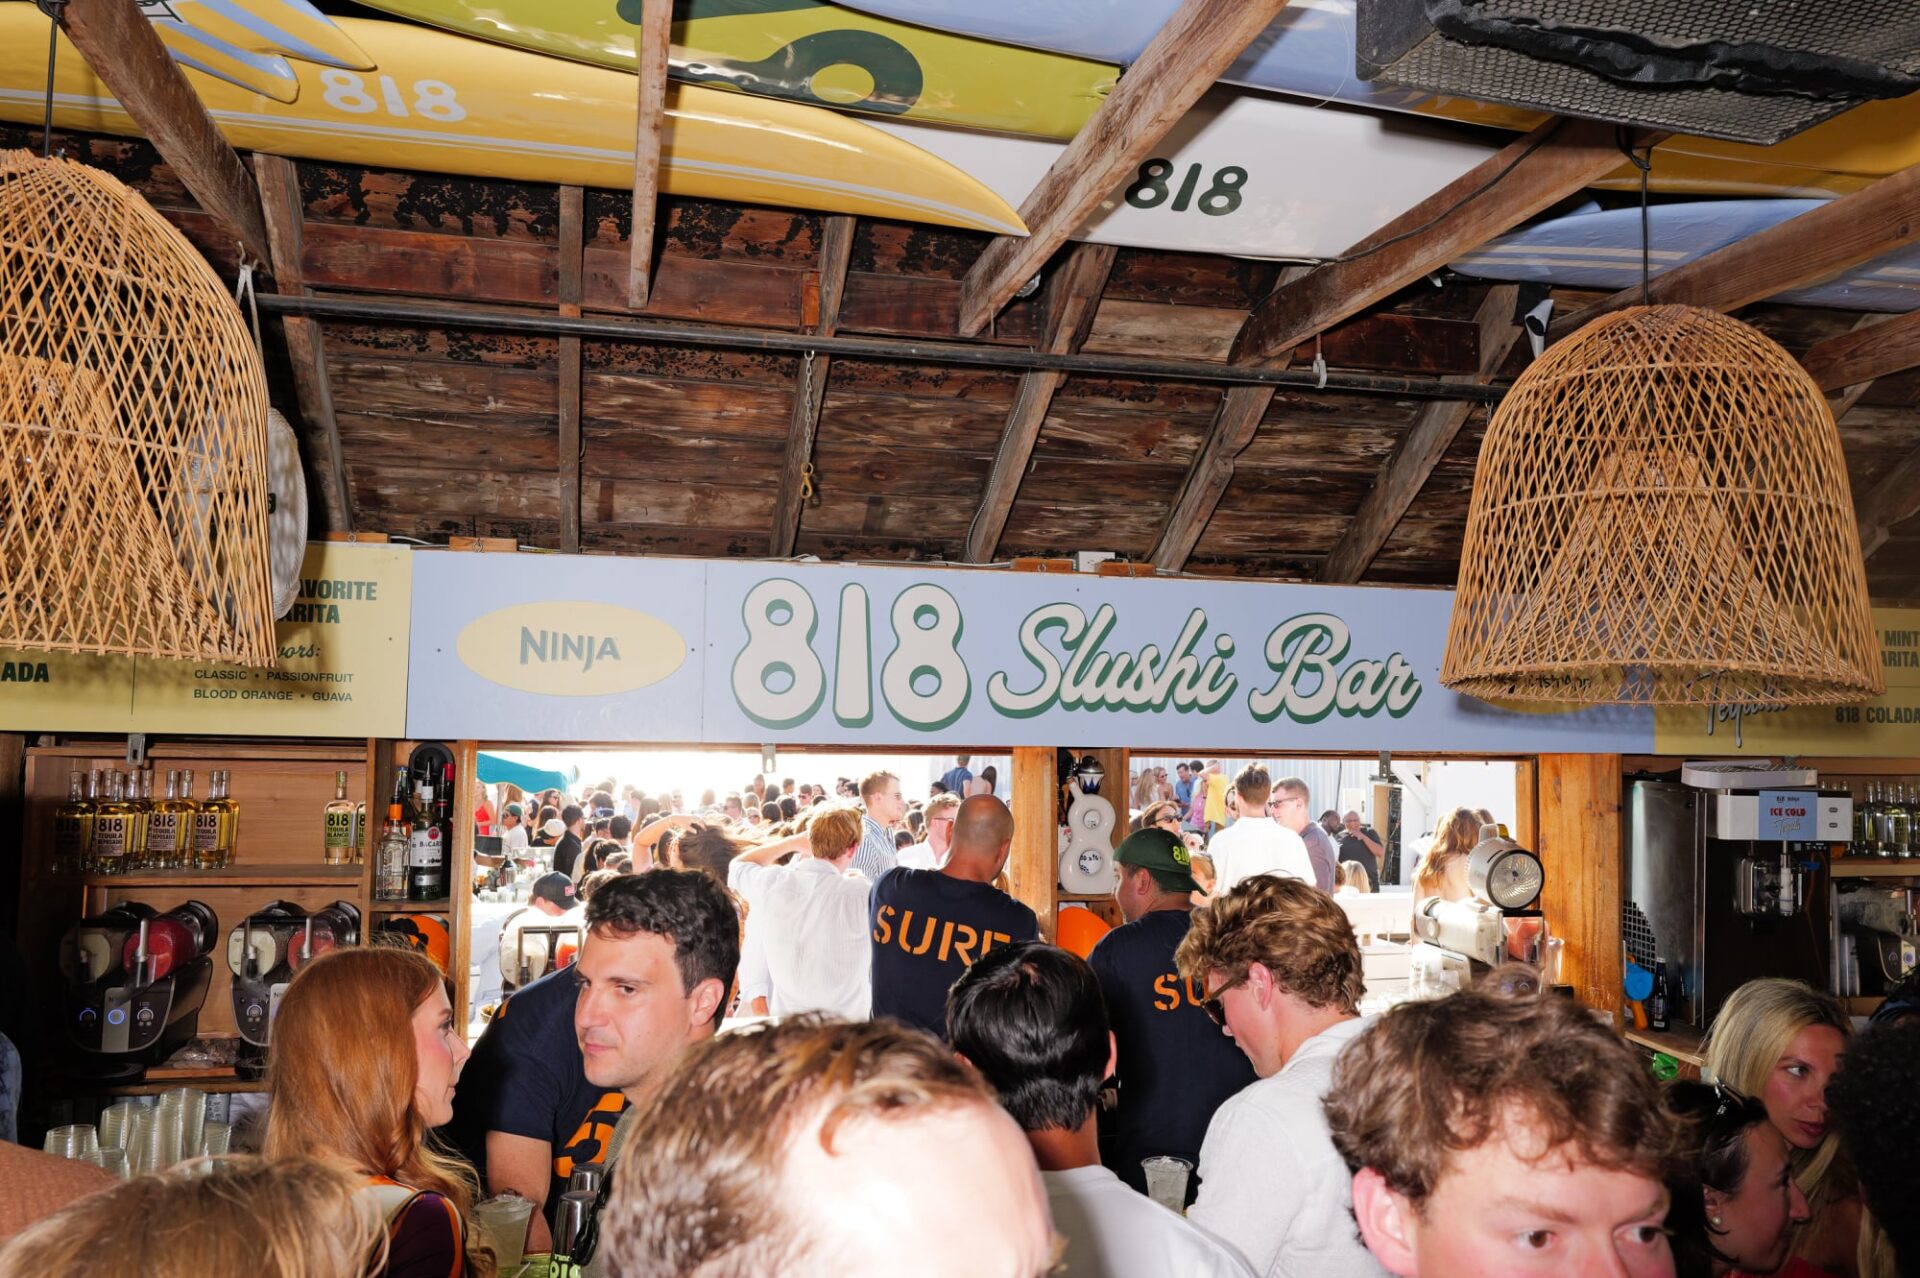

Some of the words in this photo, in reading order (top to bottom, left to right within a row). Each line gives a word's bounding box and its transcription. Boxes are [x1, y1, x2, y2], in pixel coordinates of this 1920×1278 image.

[320, 69, 467, 122] 818
[1125, 158, 1248, 216] 818
[1884, 630, 1920, 647] MINT
[520, 626, 621, 673] NINJA
[731, 577, 972, 732] 818
[987, 602, 1238, 720] Slushi
[1247, 612, 1423, 725] Bar
[1, 662, 50, 682] ADA
[194, 670, 247, 680] CLASSIC
[266, 671, 354, 683] PASSIONFRUIT
[194, 688, 238, 699] BLOOD
[241, 690, 293, 700] ORANGE
[312, 692, 353, 702] GUAVA
[1835, 706, 1860, 723] 818
[1866, 706, 1920, 724] COLADA
[327, 814, 349, 826] 818
[1769, 808, 1783, 816] ICE
[1785, 808, 1807, 817] COLD
[98, 818, 123, 832] 818
[153, 814, 177, 827] 818
[195, 814, 217, 827] 818
